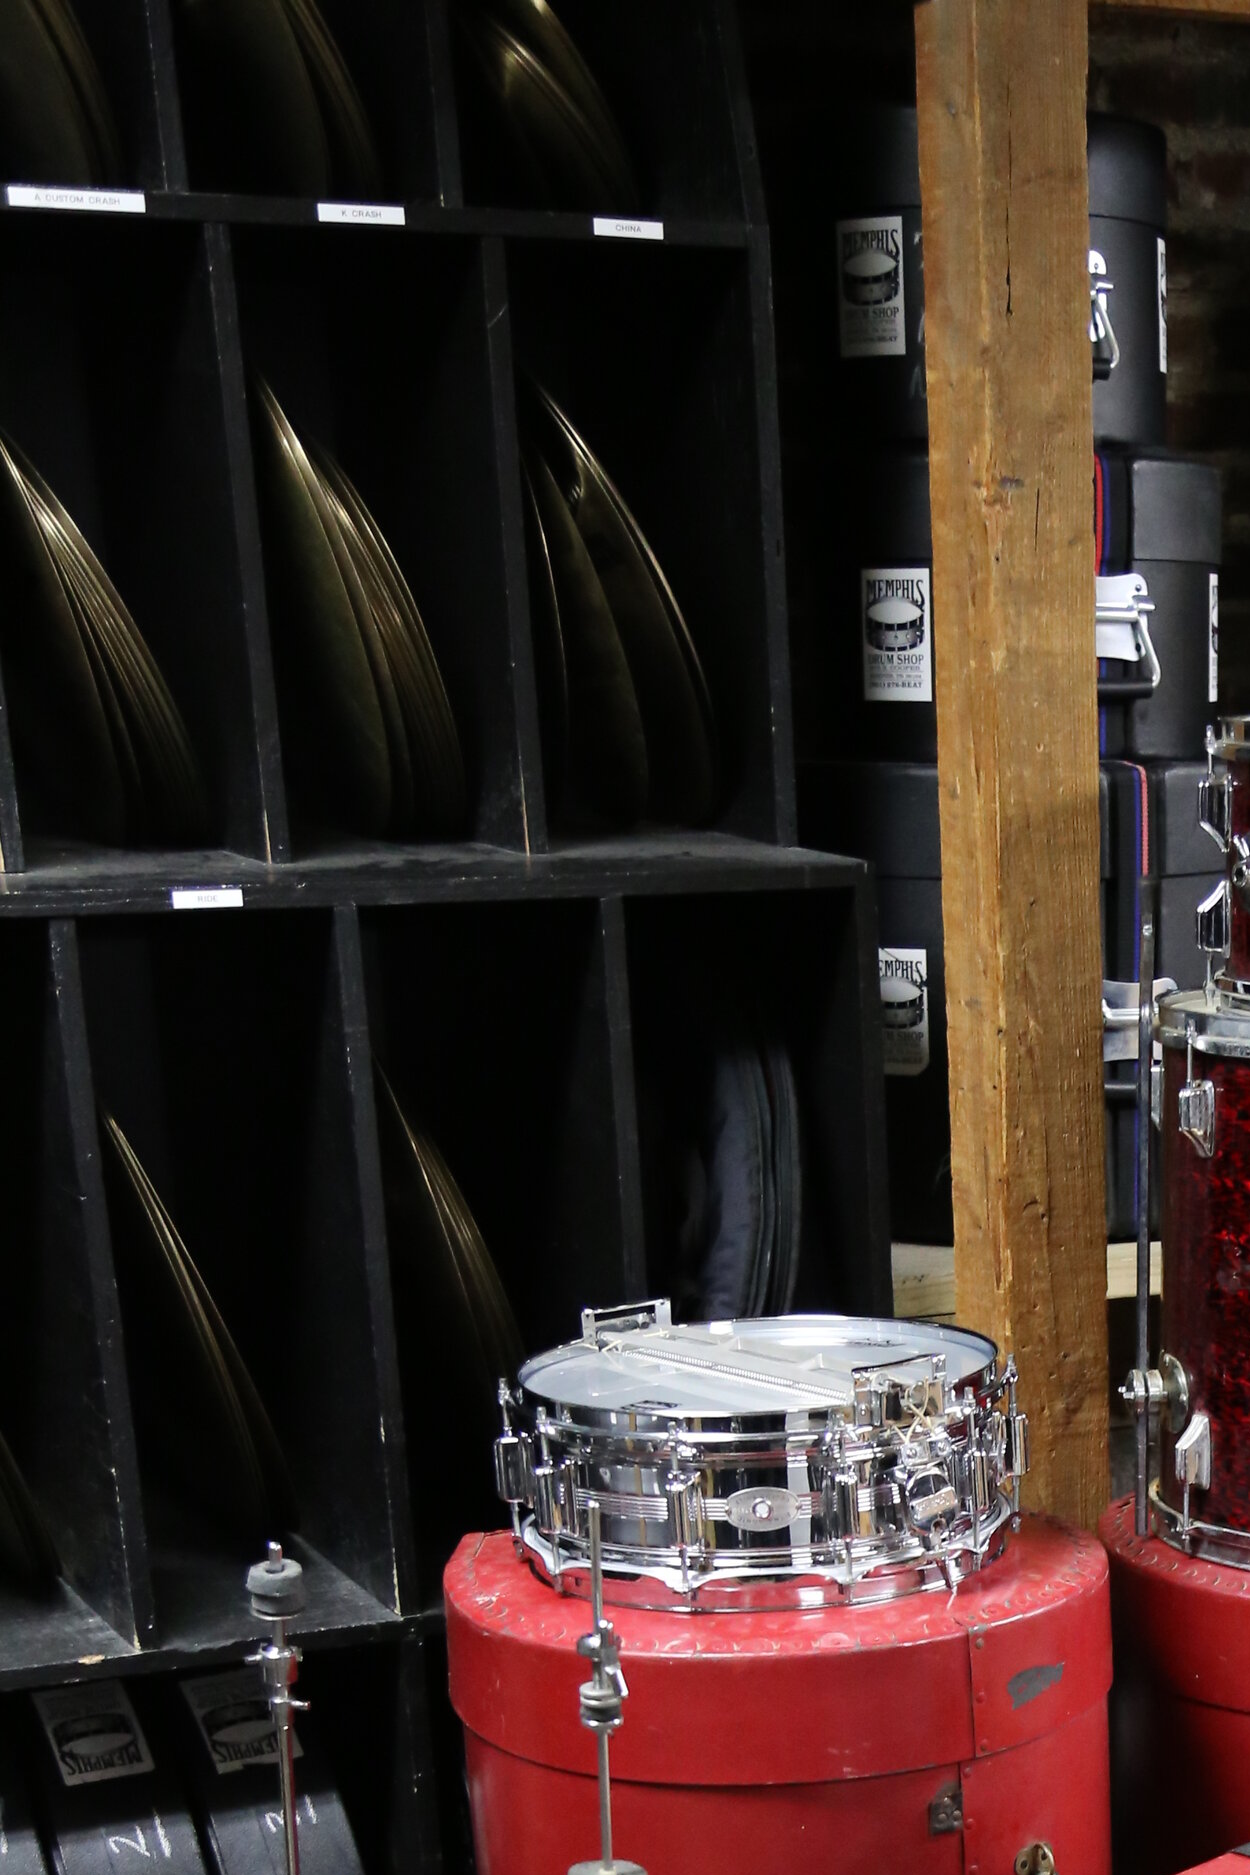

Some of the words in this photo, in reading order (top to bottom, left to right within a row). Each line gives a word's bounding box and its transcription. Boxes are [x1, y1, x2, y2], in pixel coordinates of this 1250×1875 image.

[45, 194, 84, 204] CUSTOM
[88, 196, 121, 206] CRASH
[351, 209, 383, 219] CRASH
[615, 223, 642, 233] CHINA
[842, 228, 900, 260] MEMPHIS
[872, 306, 900, 319] SHOP
[866, 579, 926, 609] MEMPHIS
[867, 654, 894, 665] DRUM
[897, 653, 925, 665] SHOP
[197, 895, 218, 903] RIDE
[879, 959, 923, 984] EMPHIS
[209, 1738, 281, 1764] EMPHIS
